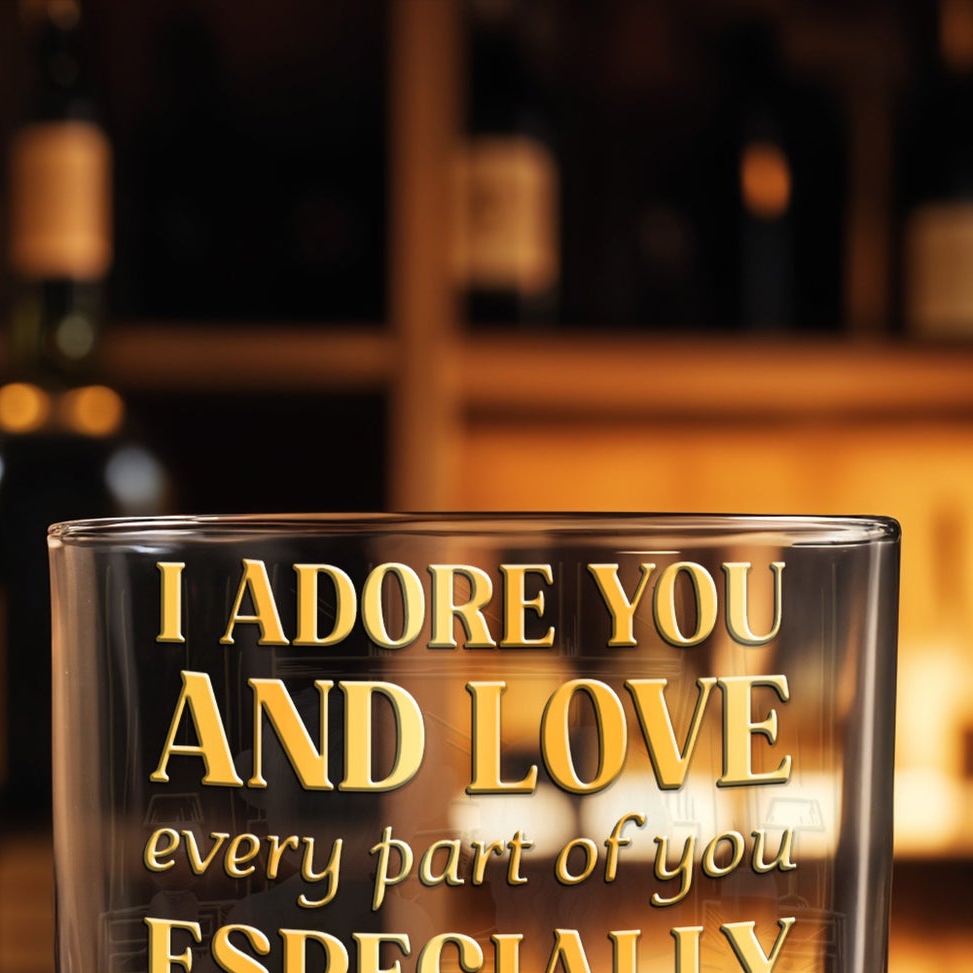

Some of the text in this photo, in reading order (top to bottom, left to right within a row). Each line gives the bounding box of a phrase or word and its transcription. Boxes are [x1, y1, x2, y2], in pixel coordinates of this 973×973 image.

[156, 559, 786, 649] I ADORE YOU
[150, 670, 792, 795] AND LOVE
[143, 812, 797, 911] every part of you
